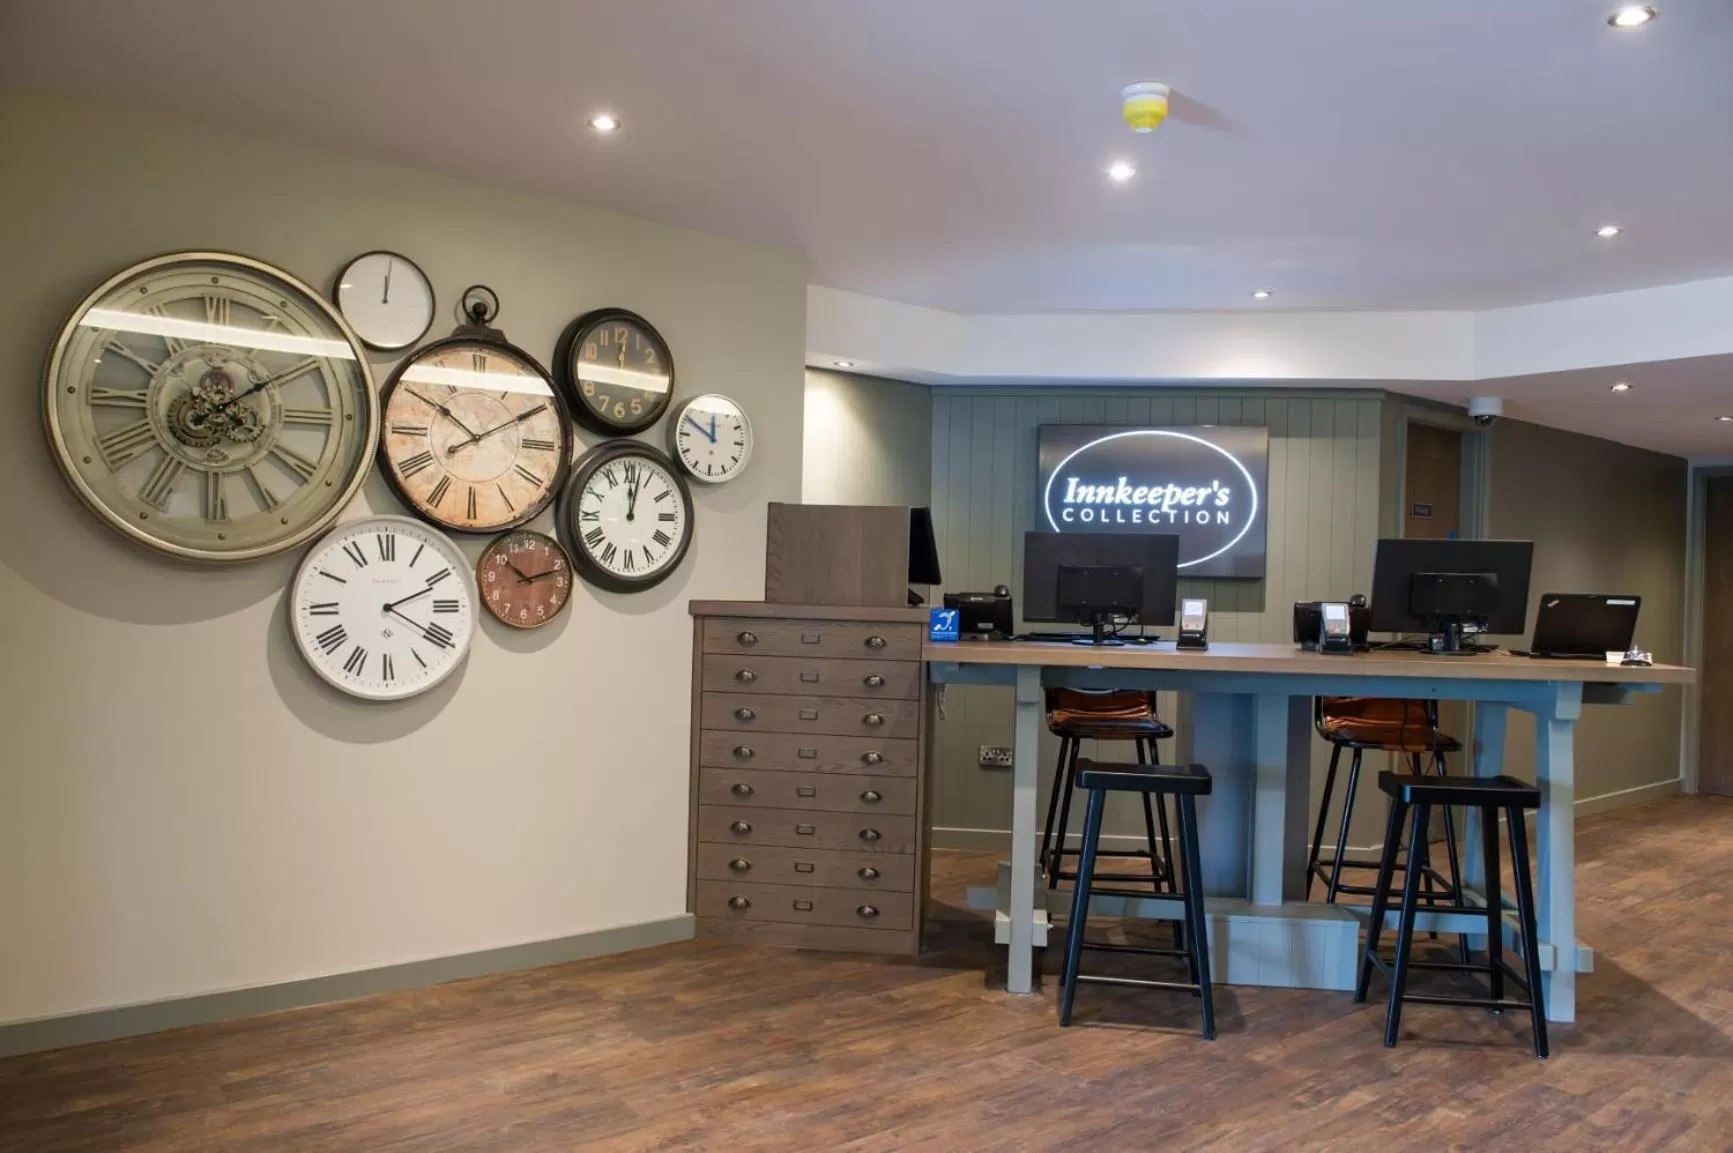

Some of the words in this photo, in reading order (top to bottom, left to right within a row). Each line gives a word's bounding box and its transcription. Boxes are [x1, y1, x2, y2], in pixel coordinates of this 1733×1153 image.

[600, 330, 609, 346] 11
[614, 327, 629, 344] 12
[584, 343, 598, 361] 10
[644, 348, 656, 365] 2
[599, 396, 611, 412] 7
[614, 402, 626, 419] 6
[630, 398, 643, 415] 5
[602, 467, 620, 489] XI
[623, 460, 636, 484] XII
[1062, 476, 1231, 512] Innkeeper's
[1061, 507, 1230, 525] COLLECTION
[509, 543, 519, 554] 11
[525, 540, 537, 551] 12
[544, 546, 550, 557] 1
[495, 554, 508, 566] 10
[553, 560, 561, 570] 2
[424, 567, 452, 588] II
[488, 571, 496, 582] 9
[556, 577, 565, 588] 3
[492, 590, 500, 601] 8
[549, 594, 557, 605] 4
[432, 599, 460, 614] III
[503, 603, 511, 614] 7
[536, 605, 544, 616] 5
[520, 609, 528, 620] 6
